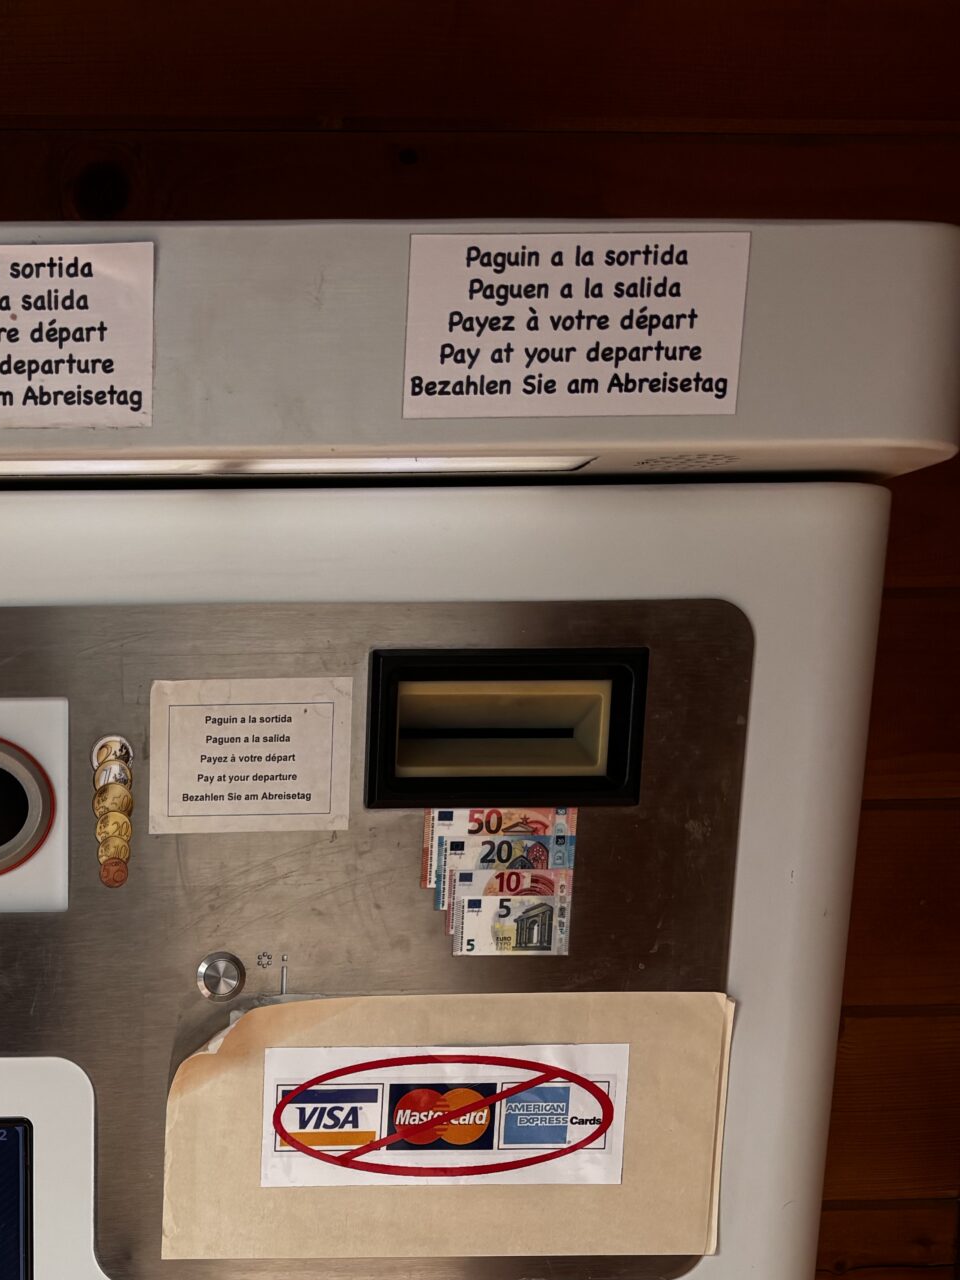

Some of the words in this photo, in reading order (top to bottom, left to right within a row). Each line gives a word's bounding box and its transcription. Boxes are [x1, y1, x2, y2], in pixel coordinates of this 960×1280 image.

[9, 256, 94, 280] sortida
[465, 245, 540, 275] Paguin
[550, 250, 564, 267] a
[575, 244, 595, 267] la
[604, 243, 689, 267] sortida
[20, 288, 89, 312] salida
[468, 278, 550, 307] Paguen
[559, 282, 573, 299] a
[584, 276, 604, 299] la
[613, 275, 682, 299] salida
[448, 310, 516, 338] Payez
[526, 306, 540, 332] à
[549, 309, 610, 332] votre
[619, 305, 699, 337] départ
[29, 318, 108, 350] départ
[439, 342, 481, 370] Pay
[490, 342, 515, 364] at
[524, 346, 577, 369] your
[585, 340, 702, 369] departure
[410, 374, 512, 397] Bezahlen
[522, 372, 557, 395] Sie
[566, 378, 599, 395] am
[606, 371, 728, 400] Abreisetag
[21, 384, 143, 413] Abreisetag
[204, 715, 238, 727] Paguin
[239, 716, 246, 724] a
[248, 715, 257, 724] la
[259, 714, 293, 724] sortida
[205, 735, 242, 746] Paguen
[243, 736, 250, 744] a
[251, 734, 261, 743] la
[262, 733, 291, 743] salida
[200, 754, 229, 766] Payez
[230, 753, 236, 763] à
[238, 754, 263, 763] votre
[264, 753, 296, 764] départ
[197, 773, 215, 785] Pay
[216, 773, 227, 782] at
[228, 774, 250, 784] your
[251, 772, 298, 784] departure
[181, 792, 225, 802] Bezahlen
[227, 792, 242, 801] Sie
[244, 793, 259, 801] am
[260, 791, 312, 802] Abreisetag
[468, 809, 502, 834] 50
[480, 840, 512, 863] 20
[495, 872, 521, 892] 10
[498, 899, 511, 918] 5
[466, 939, 475, 951] 5
[296, 1107, 360, 1129] VISA
[395, 1109, 488, 1125] MasteCard
[506, 1103, 566, 1114] AMERICAN
[518, 1115, 568, 1126] EXPRESS
[570, 1116, 602, 1126] Cards
